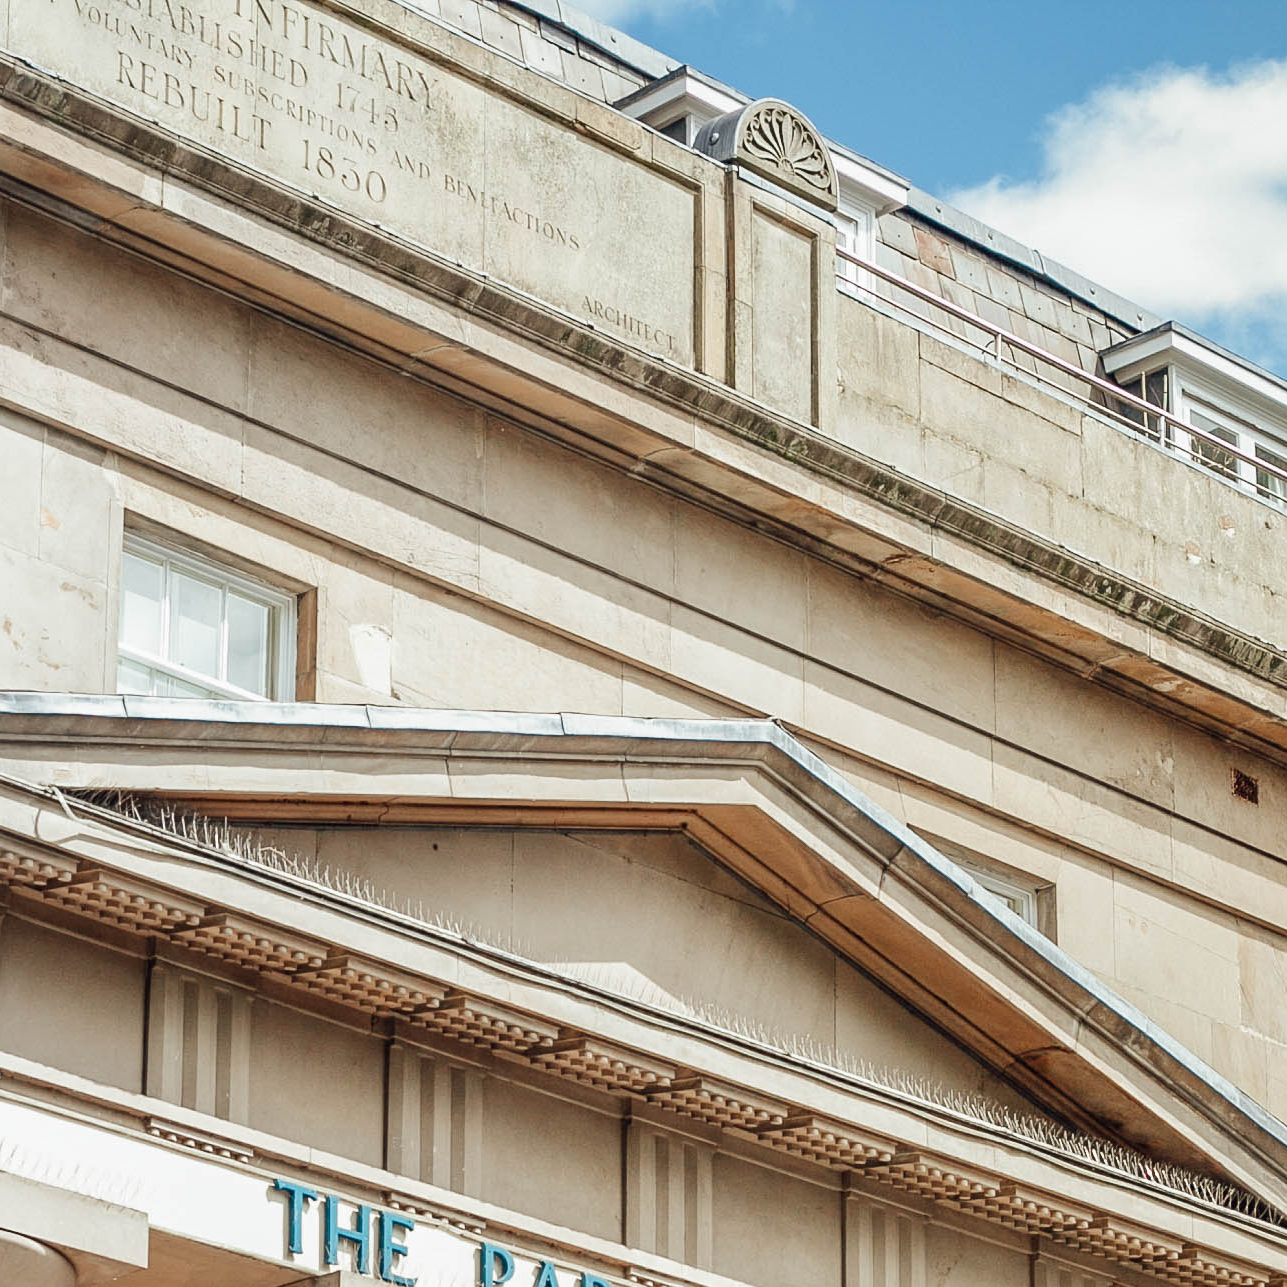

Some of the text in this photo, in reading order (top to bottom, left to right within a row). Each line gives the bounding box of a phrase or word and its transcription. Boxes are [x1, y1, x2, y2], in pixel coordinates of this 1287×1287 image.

[116, 50, 387, 204] REBUILT 1830
[214, 65, 378, 155] SUBSCRIPTIONS
[391, 150, 431, 180] AND
[581, 295, 675, 351] ARCHITECT
[272, 1178, 419, 1287] THE
